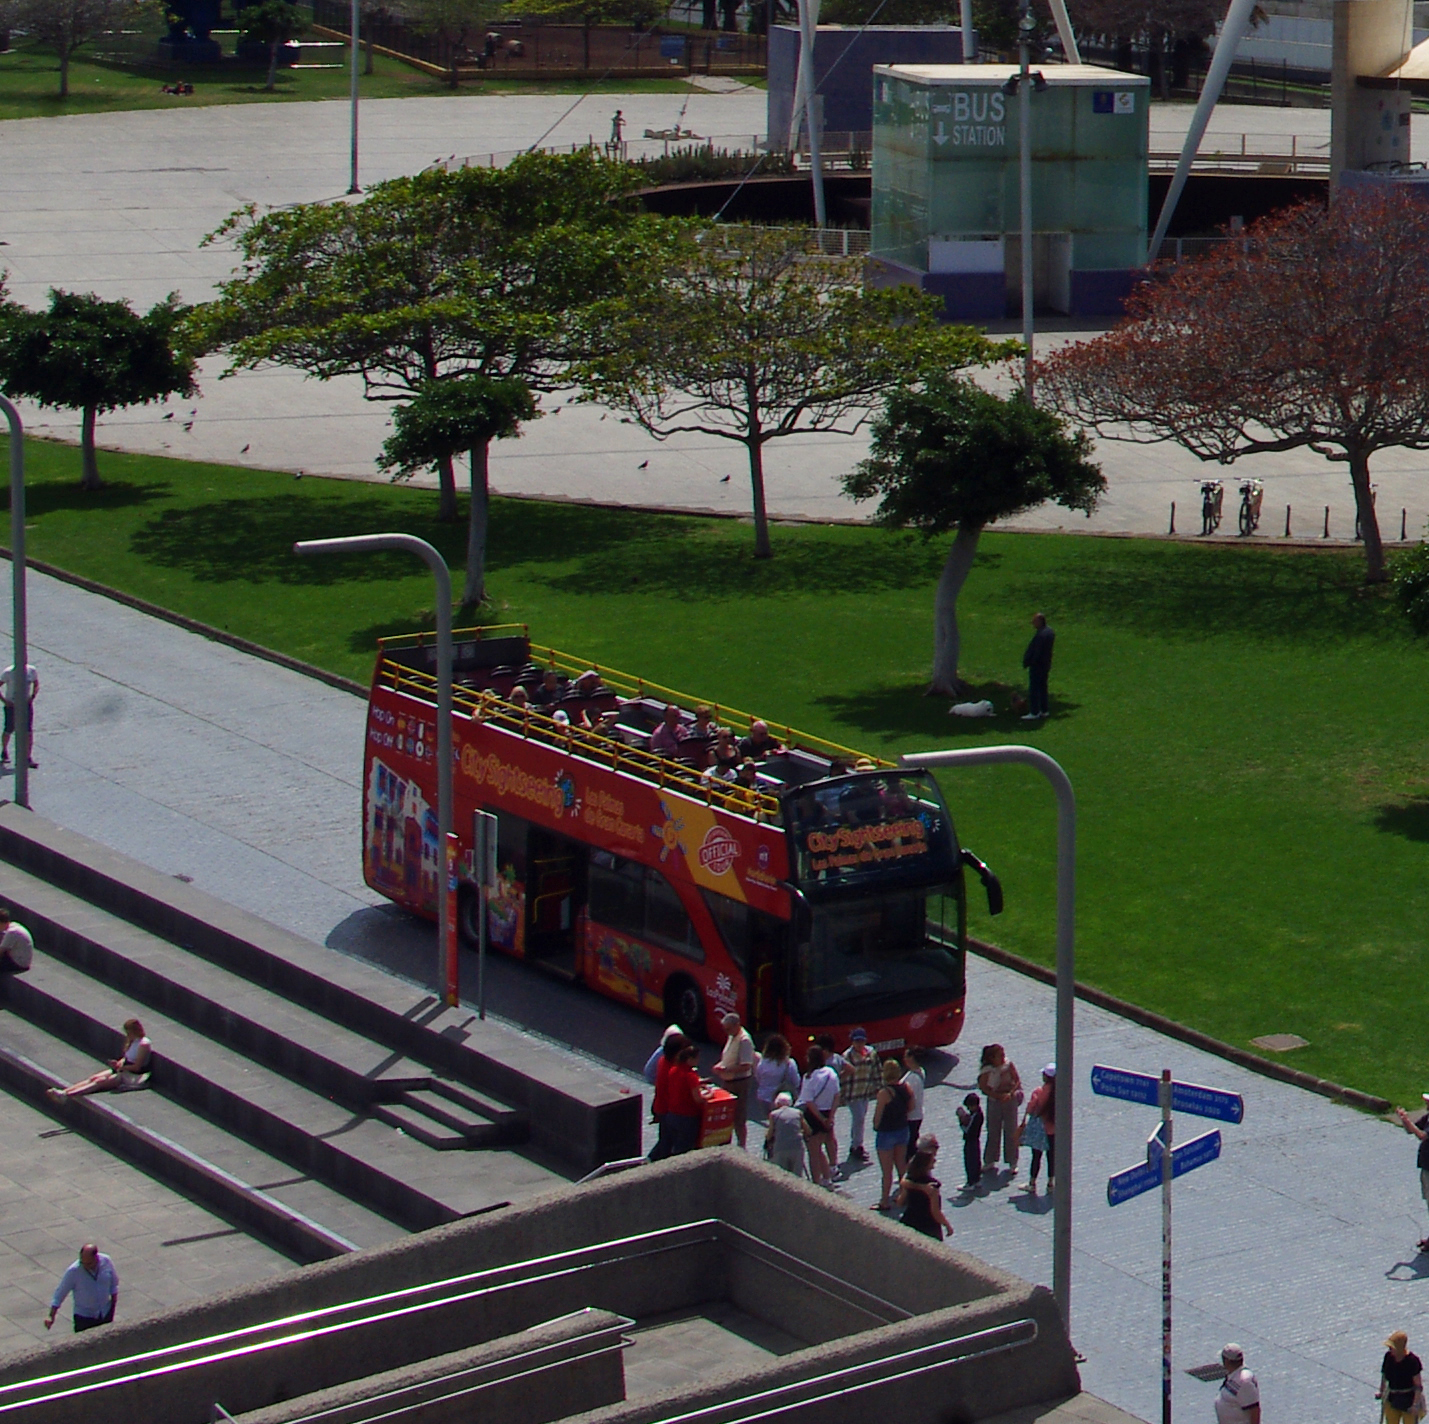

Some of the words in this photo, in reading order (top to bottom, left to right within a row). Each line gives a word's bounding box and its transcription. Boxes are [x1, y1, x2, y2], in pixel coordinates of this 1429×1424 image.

[953, 91, 1006, 123] BUS
[953, 125, 1005, 146] STATION
[701, 841, 738, 863] OFFICIAL
[1173, 1084, 1213, 1102] Amsterdam
